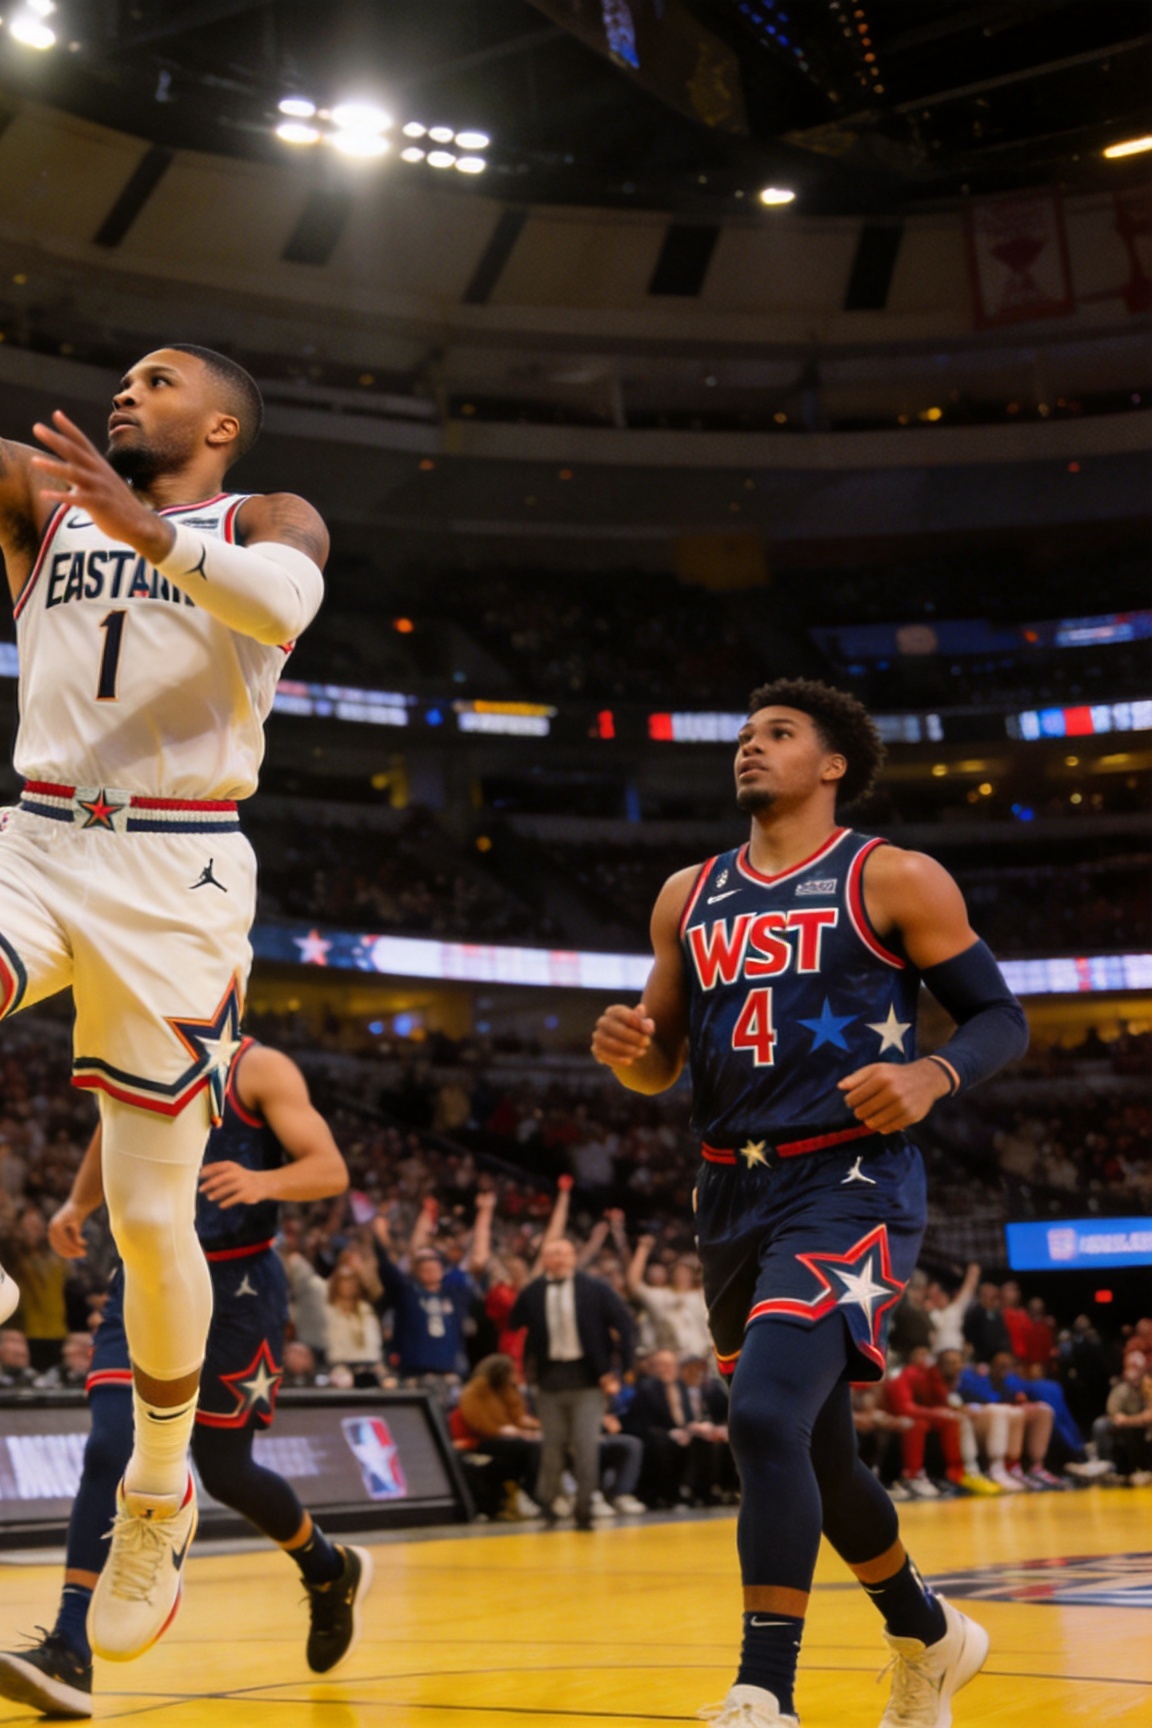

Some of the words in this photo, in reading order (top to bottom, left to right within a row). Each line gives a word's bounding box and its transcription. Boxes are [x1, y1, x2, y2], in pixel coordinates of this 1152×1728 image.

[96, 609, 128, 702] 1
[687, 907, 839, 991] WST
[732, 987, 778, 1067] 4
